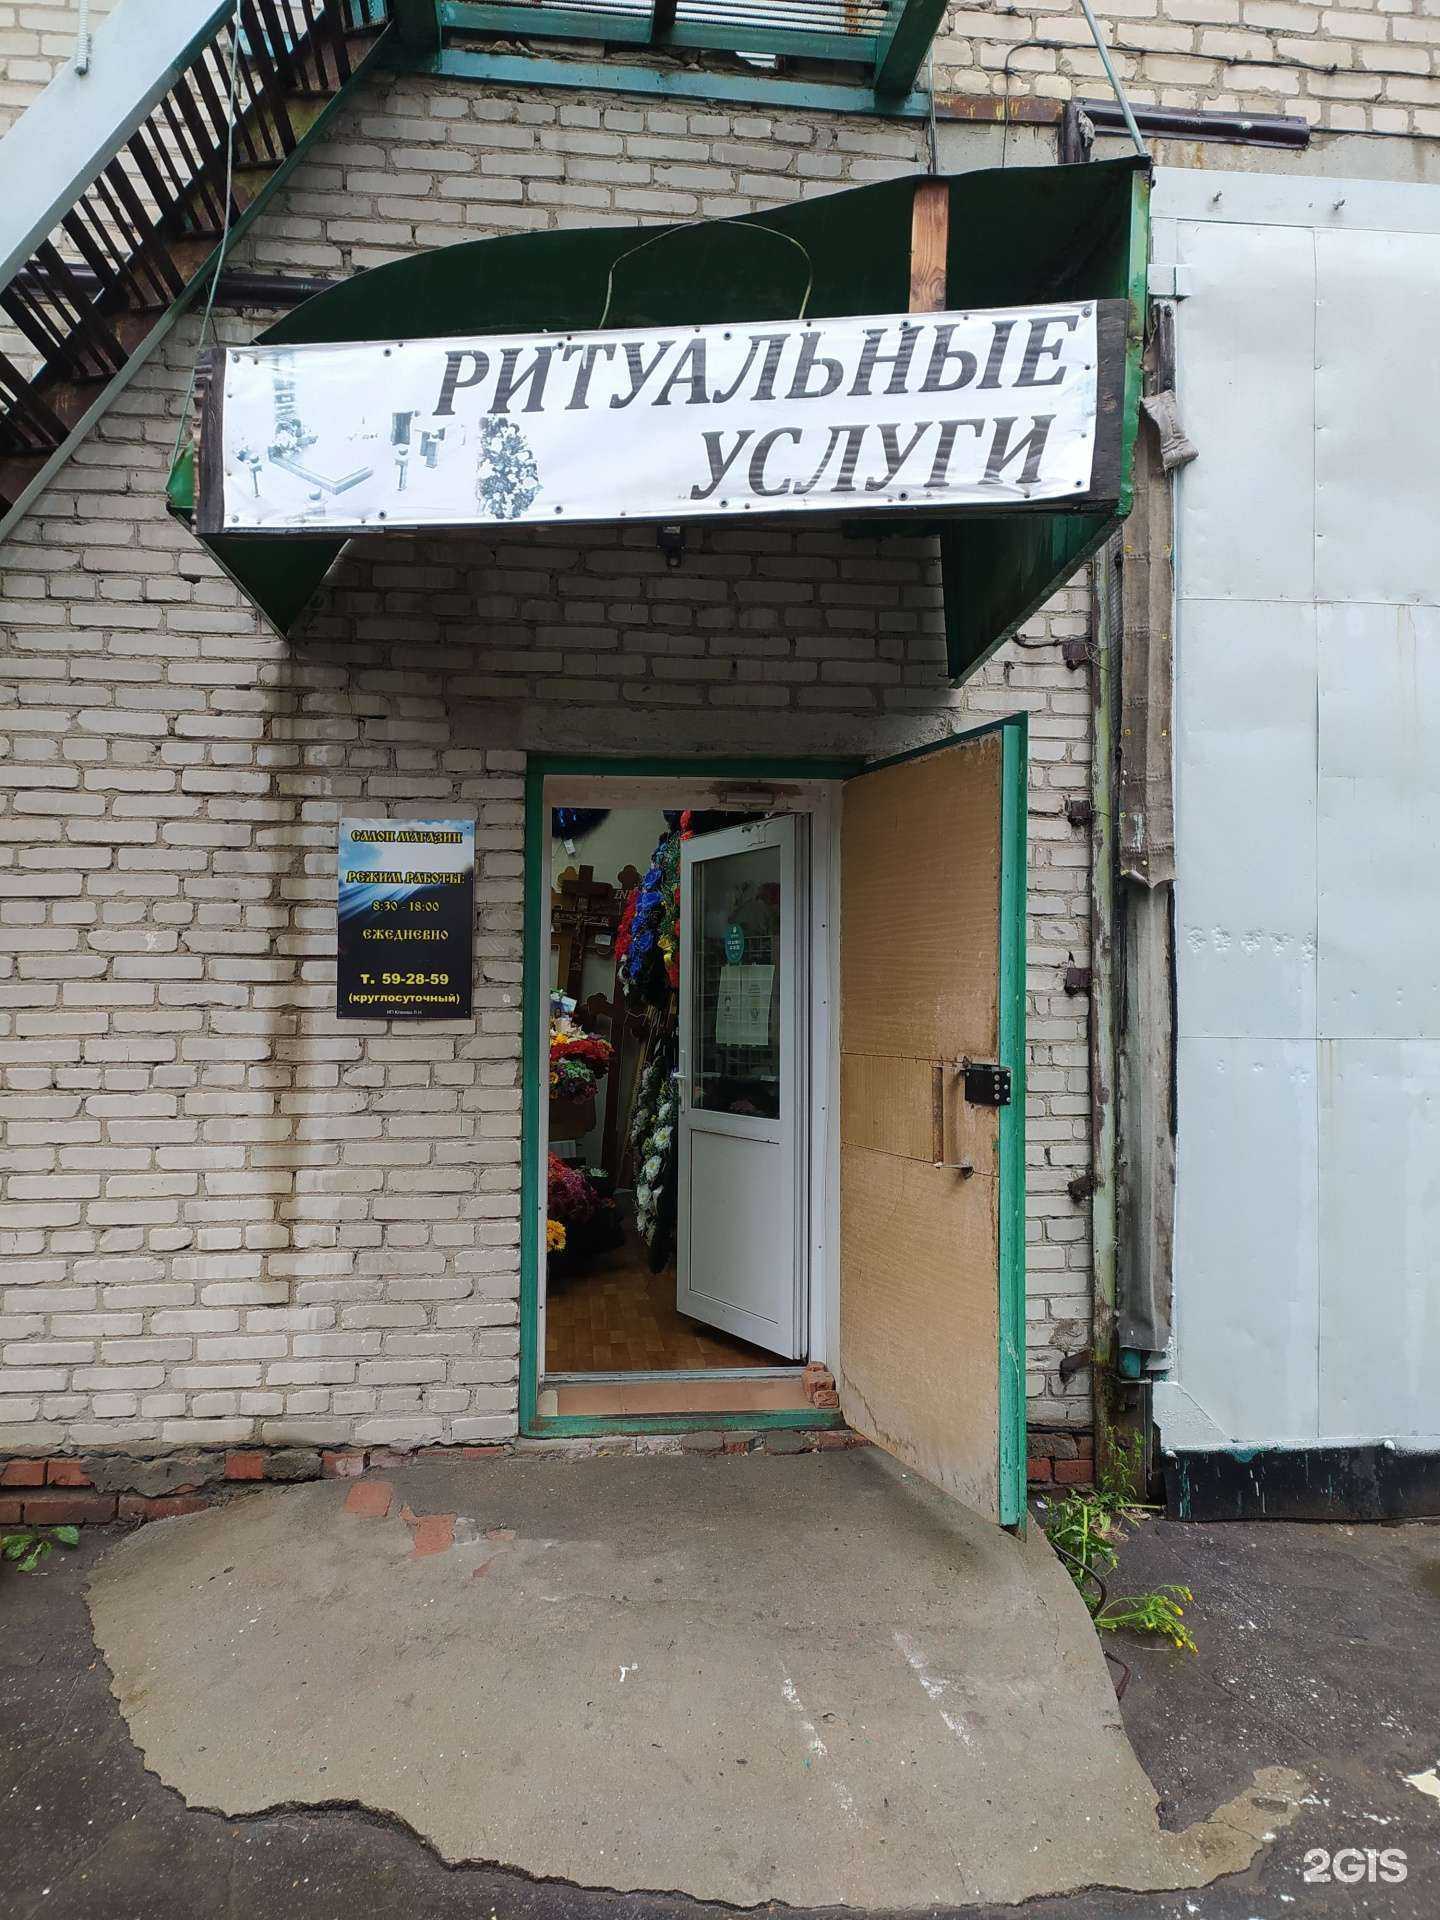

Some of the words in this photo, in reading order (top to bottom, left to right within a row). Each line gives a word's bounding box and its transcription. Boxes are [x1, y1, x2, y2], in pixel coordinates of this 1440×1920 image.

[432, 317, 1079, 415] РИТУАЛЬНЫЕ
[690, 415, 1056, 499] УСЛУГИ
[351, 830, 396, 842] САЛОН
[397, 831, 463, 844] МАГАЗИН
[346, 871, 403, 884] РЕЖИМ
[405, 872, 465, 885] РАБОТЫ
[372, 901, 398, 911] 8:30
[409, 901, 440, 912] 18:00
[362, 929, 449, 941] ЕЖЕДНЕВНО
[382, 973, 449, 985] 59-28-59
[348, 992, 461, 1005] (круглосуточный)
